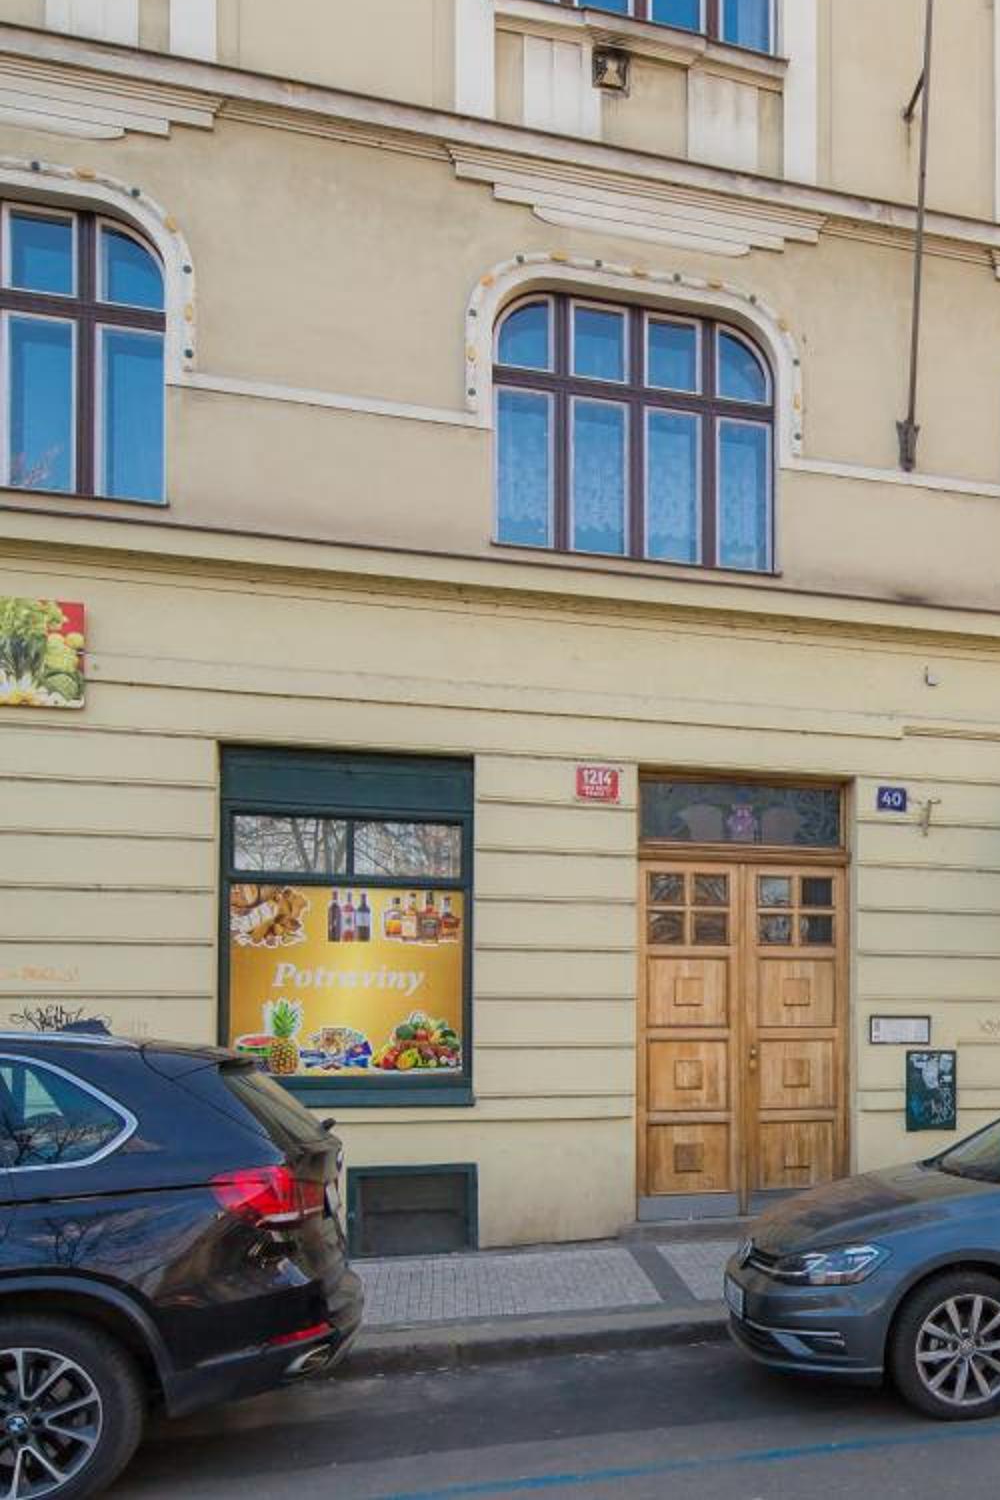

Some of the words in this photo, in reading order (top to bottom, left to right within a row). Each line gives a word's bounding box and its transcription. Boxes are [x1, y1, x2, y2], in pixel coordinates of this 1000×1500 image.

[583, 768, 611, 786] 1214
[881, 791, 902, 806] 40
[271, 962, 425, 997] Potraviny
